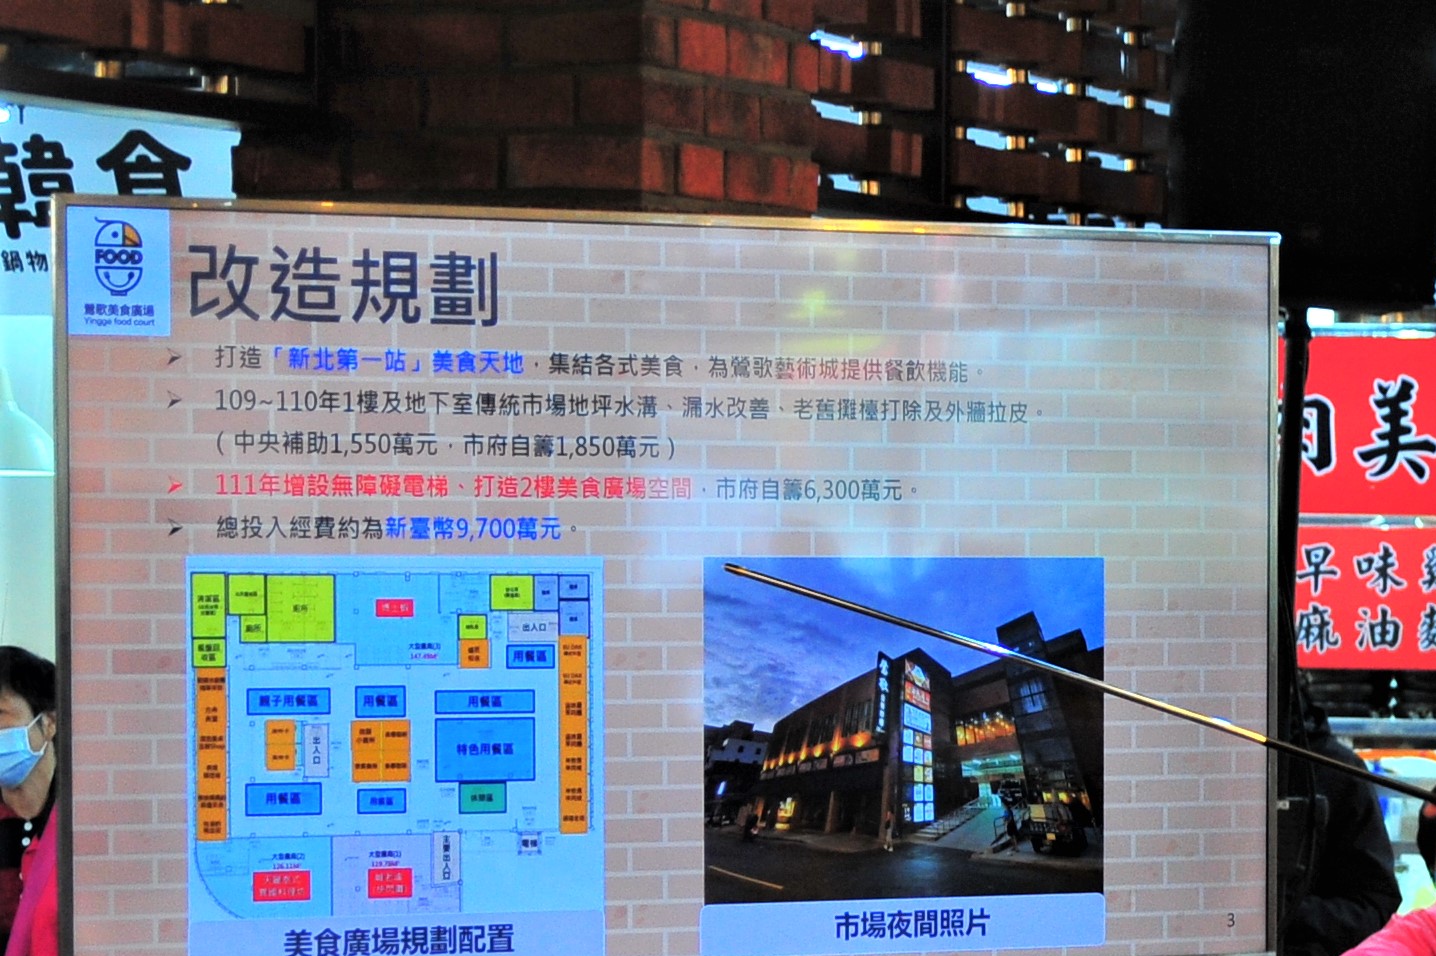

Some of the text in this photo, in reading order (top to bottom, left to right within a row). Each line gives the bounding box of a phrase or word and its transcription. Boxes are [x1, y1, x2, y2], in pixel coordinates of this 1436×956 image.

[95, 249, 143, 265] FOOD
[187, 243, 499, 327] 改造規劃
[84, 317, 155, 327] Yingge food court
[513, 650, 547, 662] 用餐區
[259, 694, 318, 707] 親子用餐區
[363, 695, 398, 707] 用餐區
[468, 695, 502, 707] 用餐區
[456, 743, 514, 756] 特色用餐區
[266, 792, 301, 805] 用餐區
[834, 908, 991, 941] 市場夜間照片
[1227, 913, 1236, 928] 3
